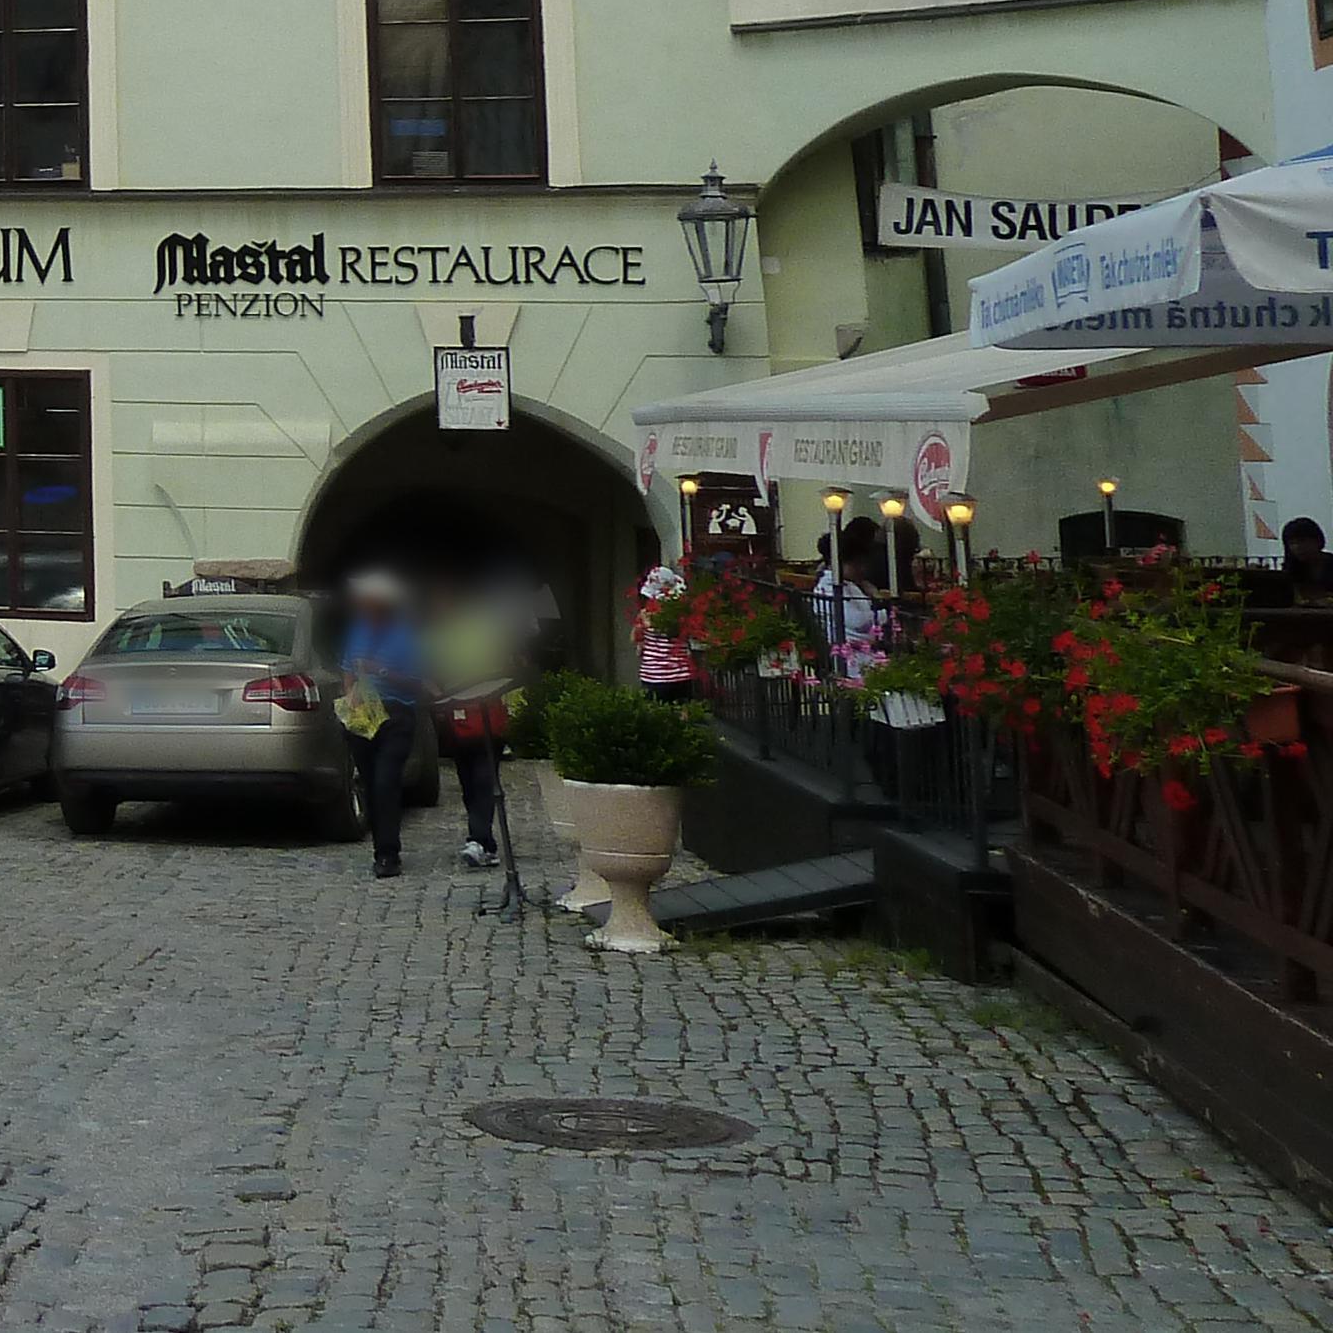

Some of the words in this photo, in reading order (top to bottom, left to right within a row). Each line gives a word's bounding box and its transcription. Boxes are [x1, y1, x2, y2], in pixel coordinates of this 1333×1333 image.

[893, 197, 973, 238] JAN
[338, 245, 647, 286] RESTAURACE
[175, 292, 324, 318] PENZION
[793, 438, 849, 465] RESTAURANT
